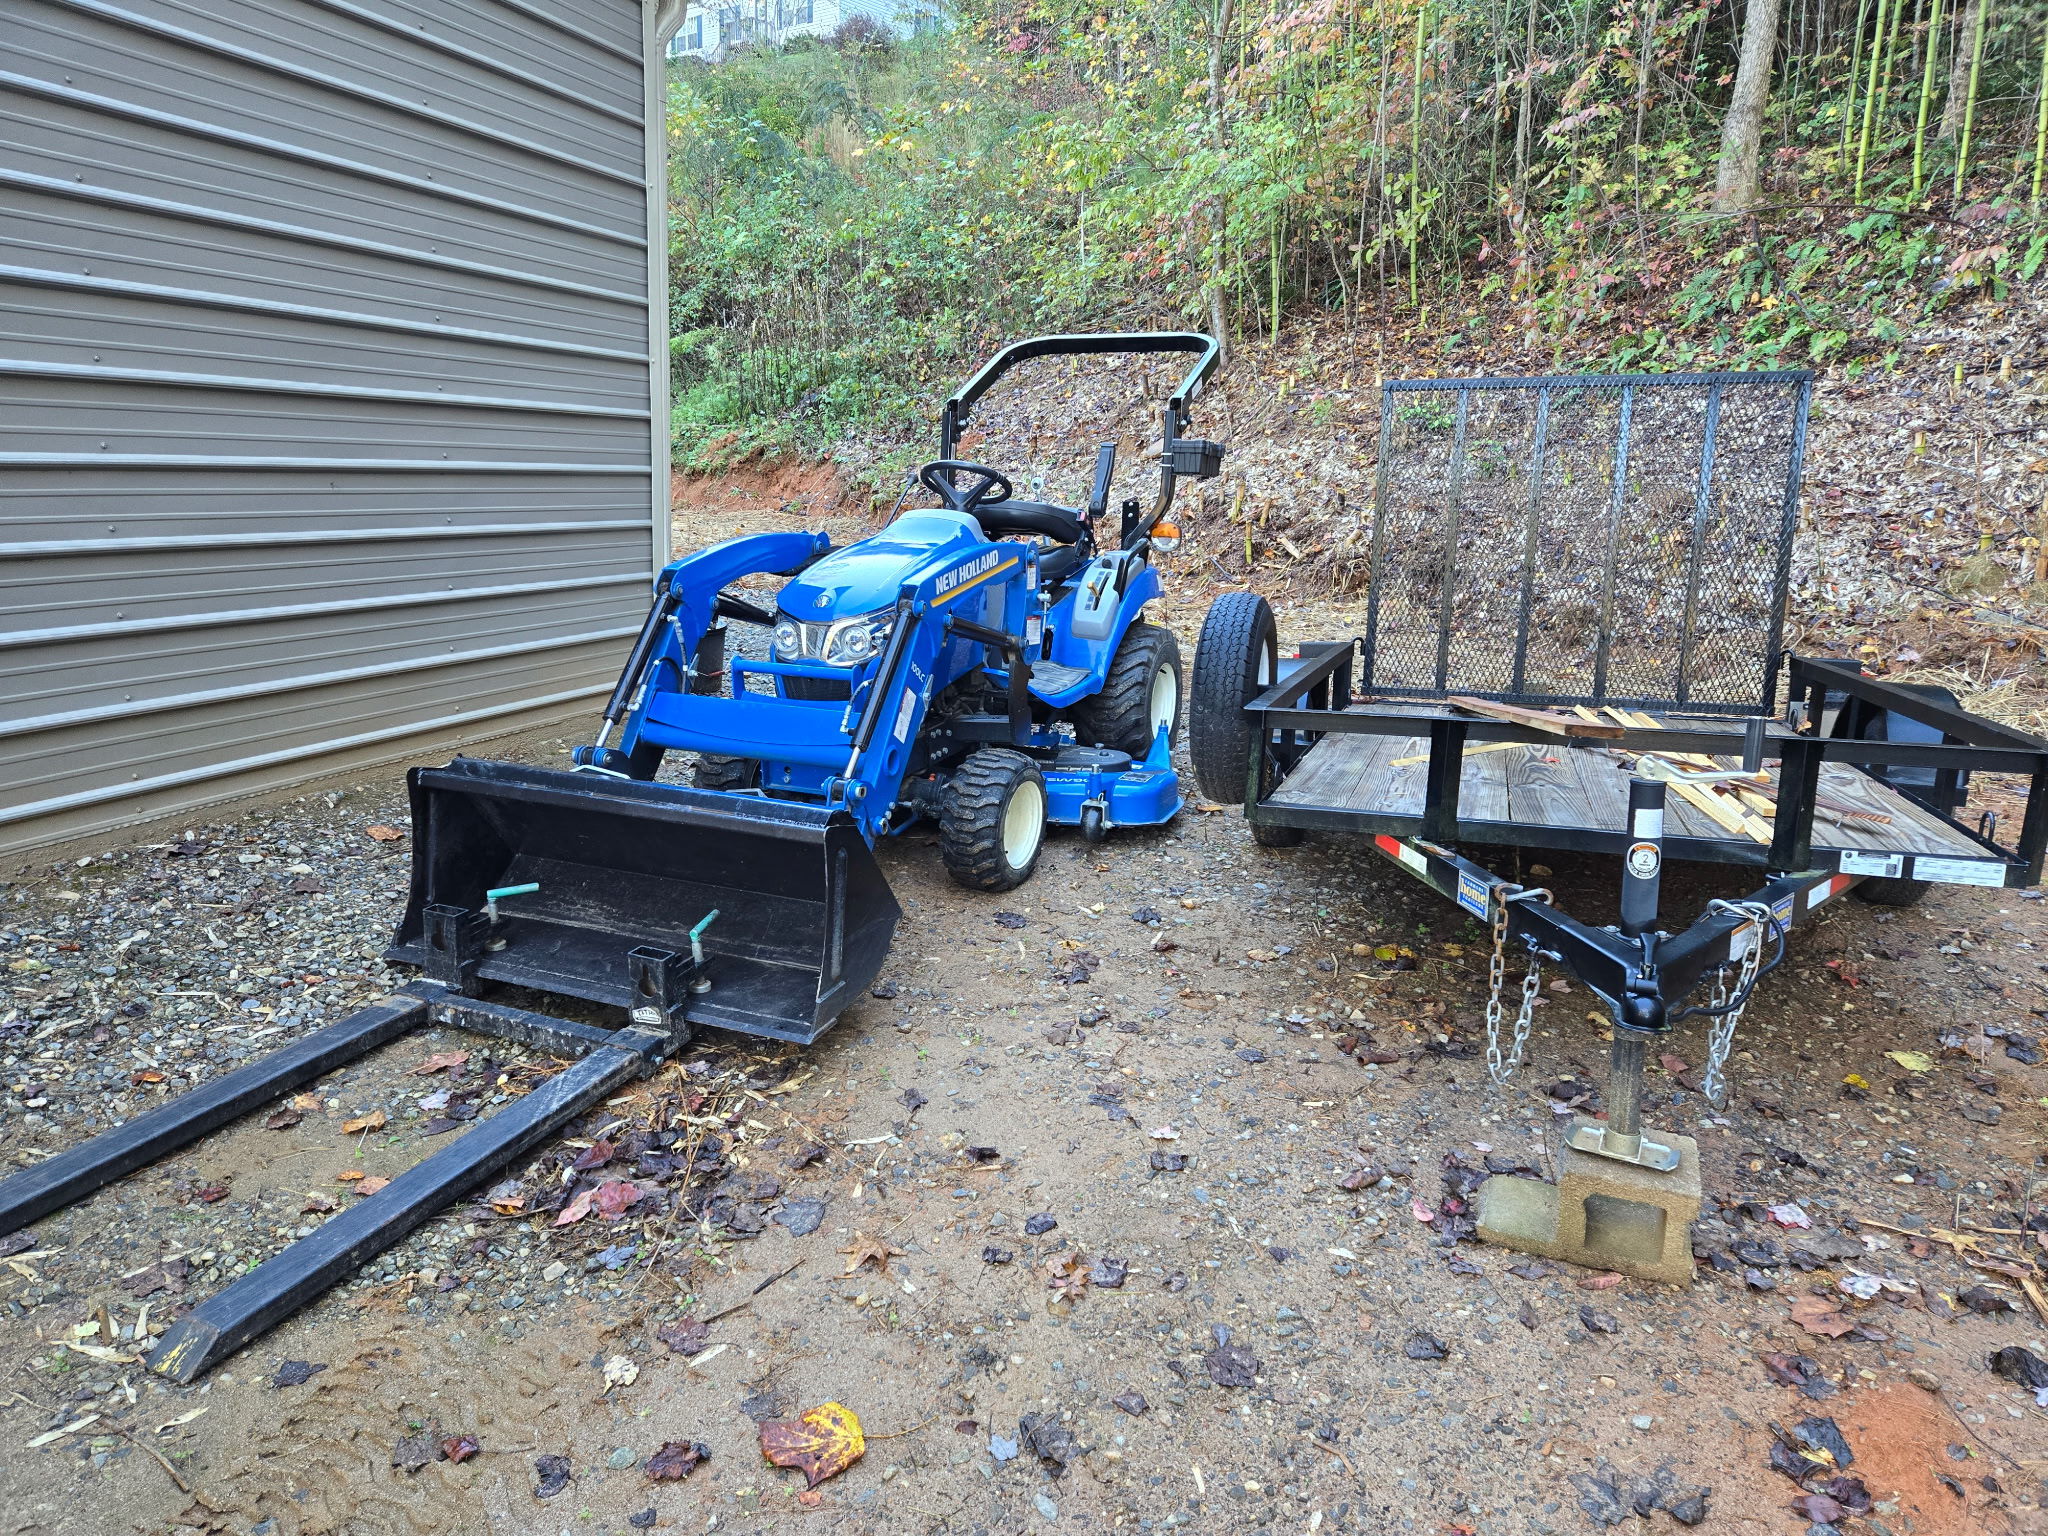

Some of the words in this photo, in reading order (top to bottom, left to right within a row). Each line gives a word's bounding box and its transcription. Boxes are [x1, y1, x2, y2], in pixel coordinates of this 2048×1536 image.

[935, 568, 958, 595] NEW
[959, 549, 999, 583] HOLLAND
[1460, 878, 1486, 905] home
